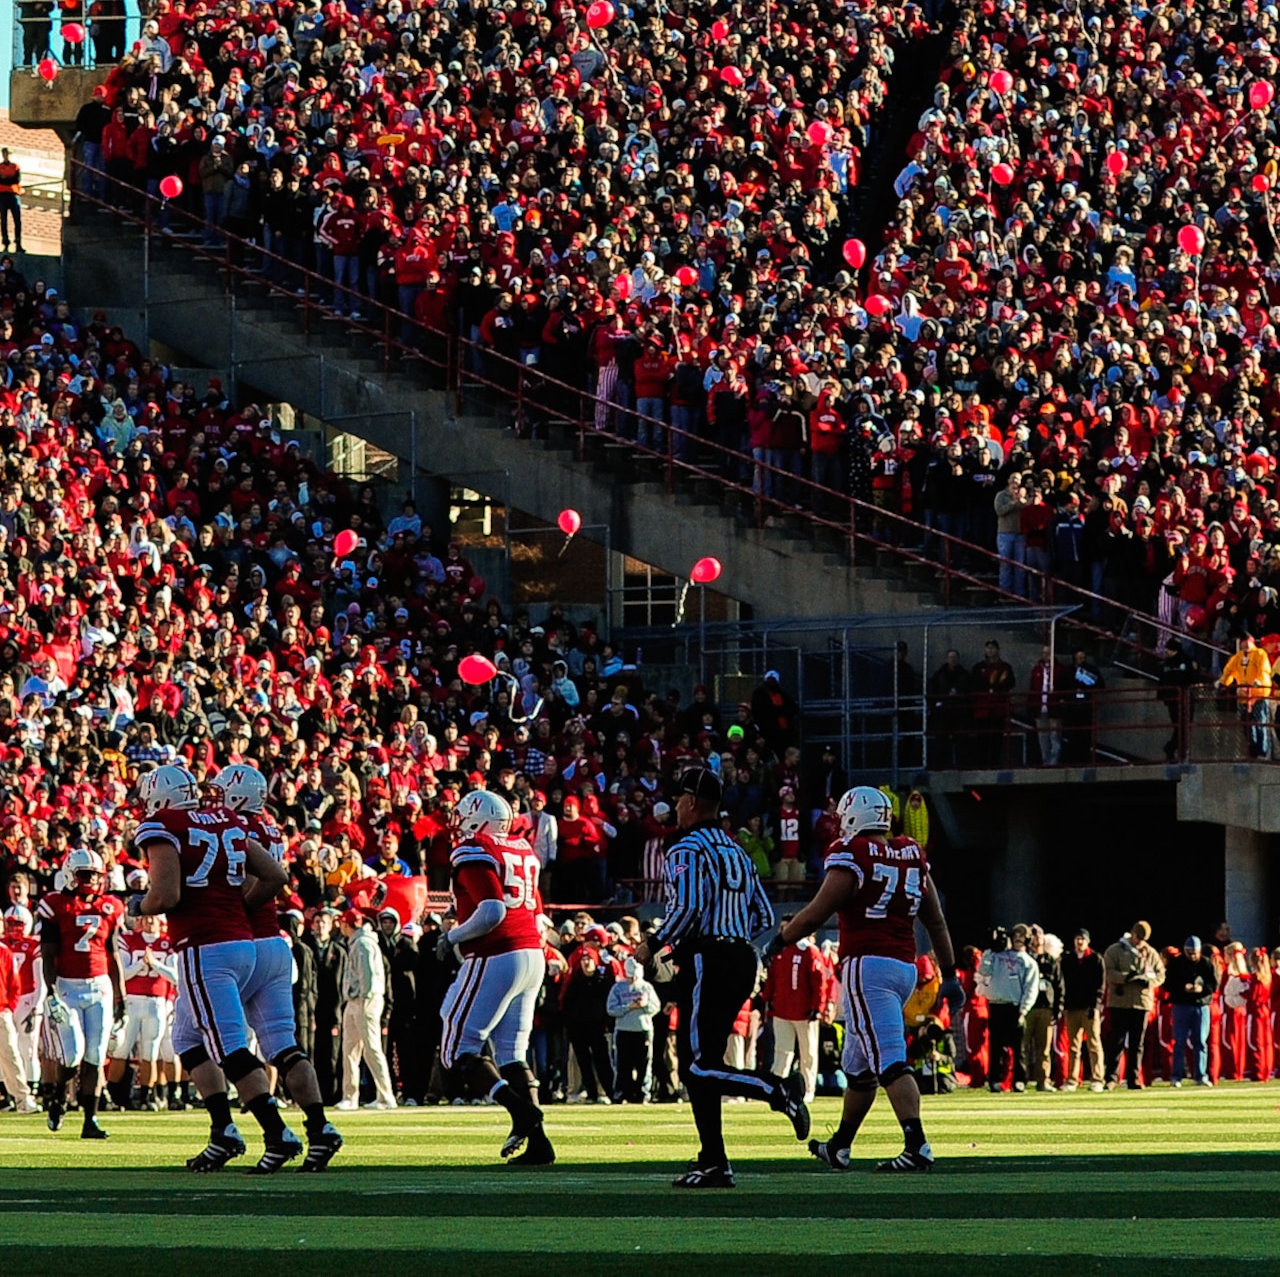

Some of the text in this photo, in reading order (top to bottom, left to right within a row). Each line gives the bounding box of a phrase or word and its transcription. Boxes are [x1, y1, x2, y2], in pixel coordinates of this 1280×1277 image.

[780, 819, 799, 841] 12
[186, 827, 246, 887] 76
[501, 852, 541, 910] 50
[74, 914, 101, 952] 7
